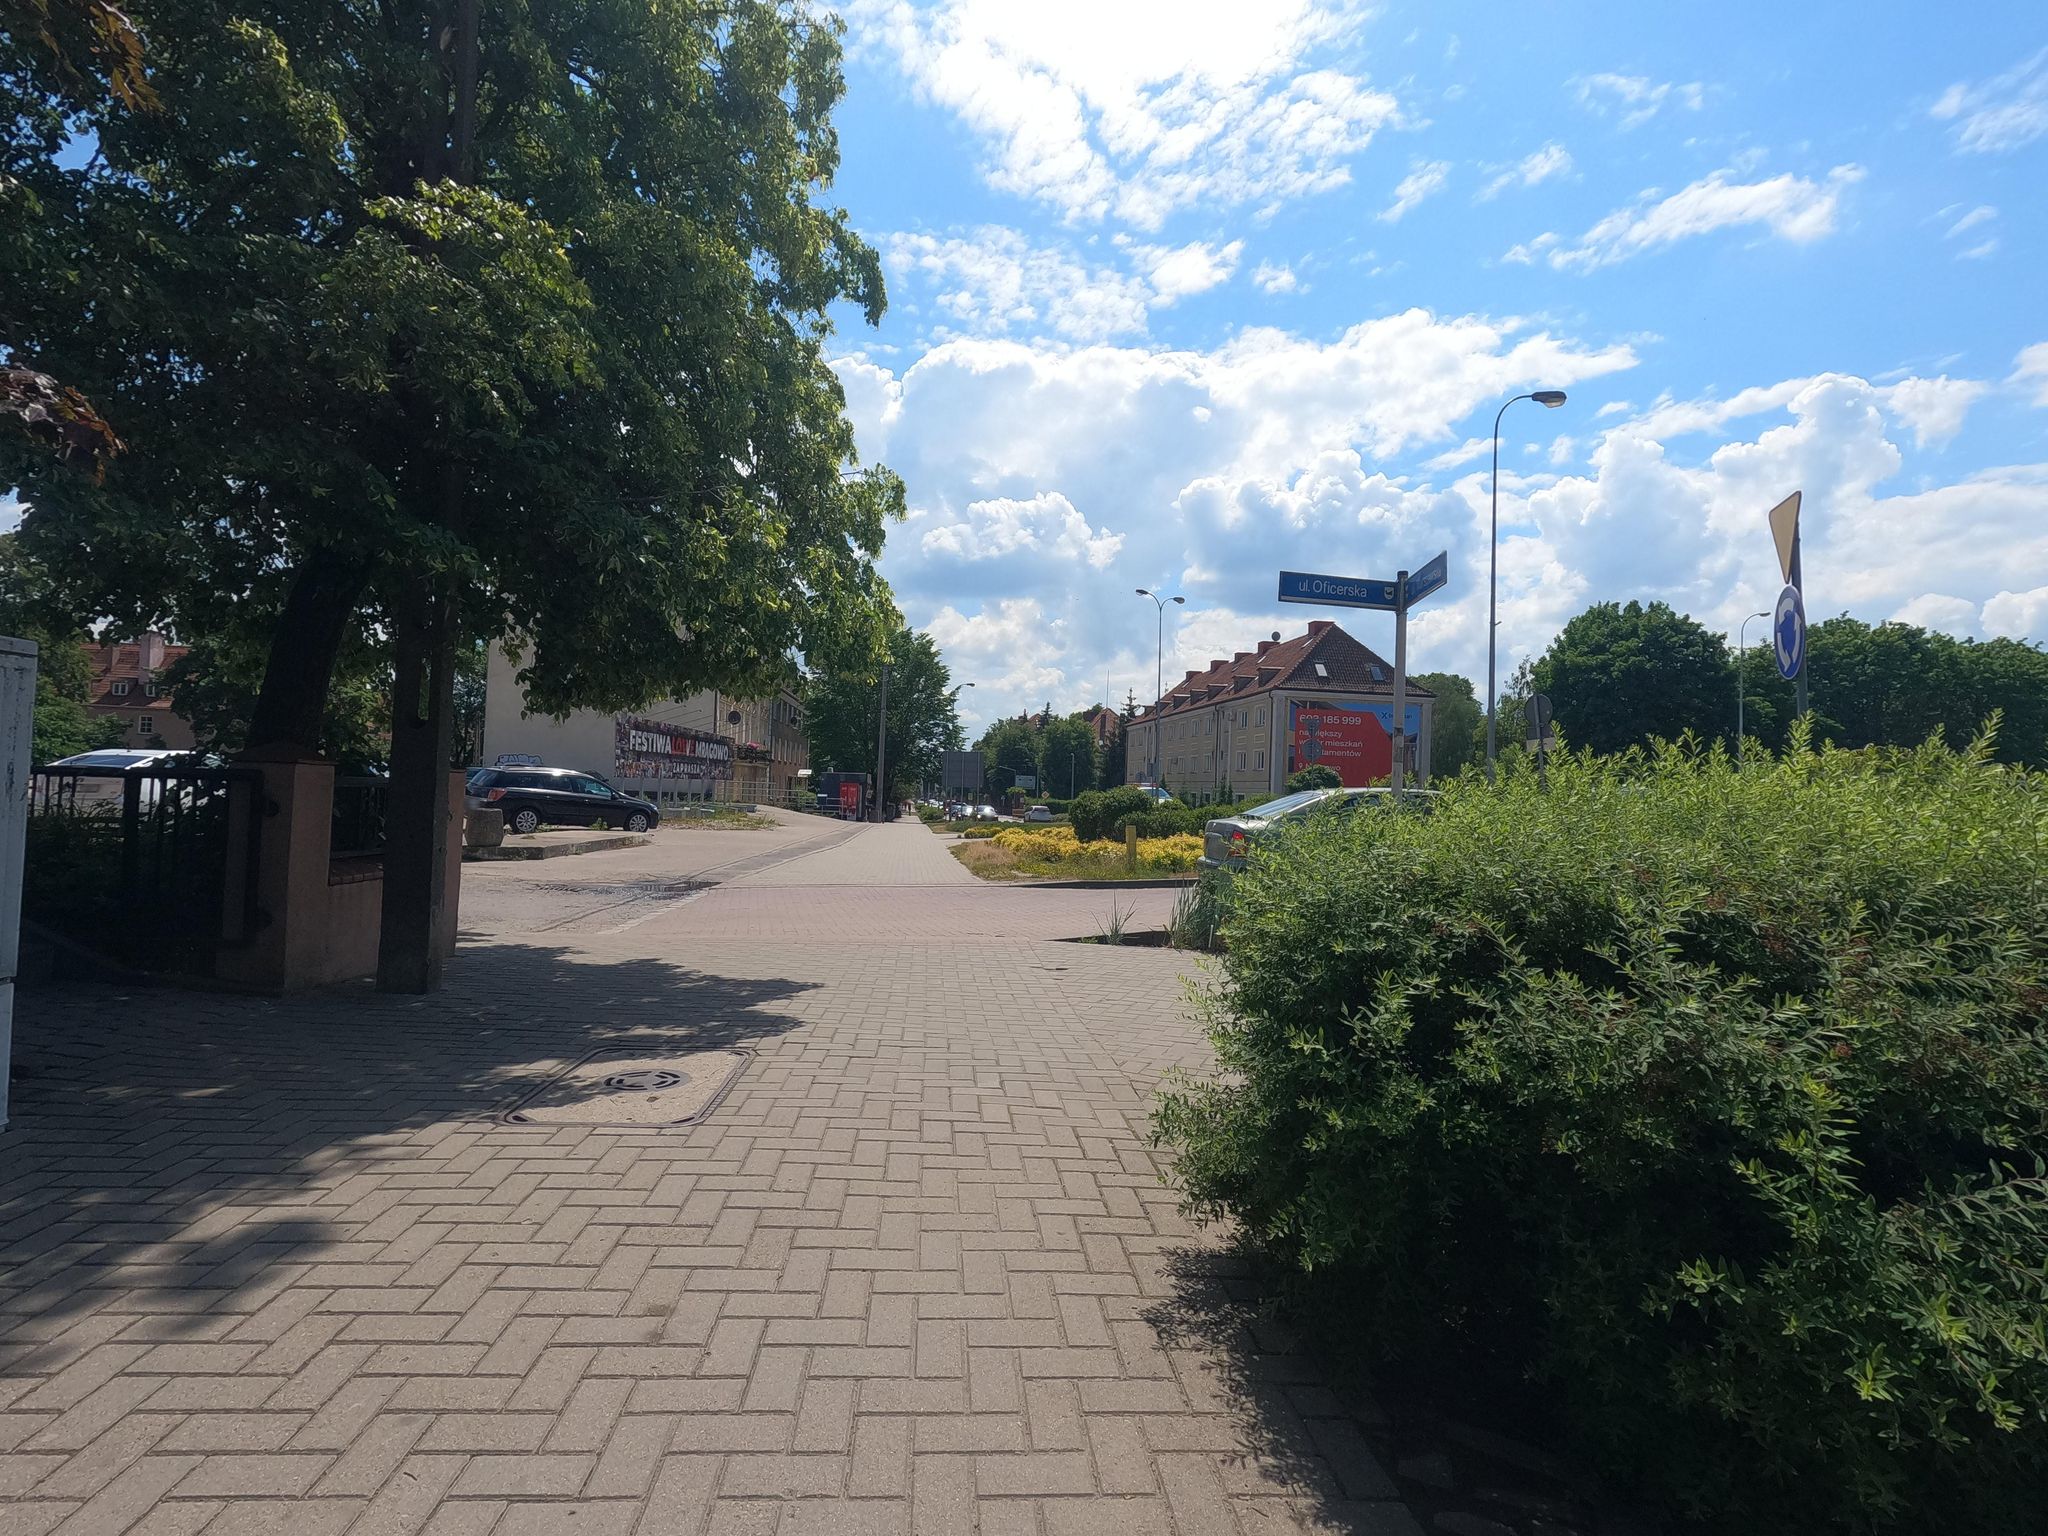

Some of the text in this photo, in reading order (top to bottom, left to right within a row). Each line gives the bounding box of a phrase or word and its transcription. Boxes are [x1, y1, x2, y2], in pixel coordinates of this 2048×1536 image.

[1299, 579, 1368, 597] ul. Oficerska
[1323, 715, 1340, 724] 185
[1342, 716, 1362, 725] 999
